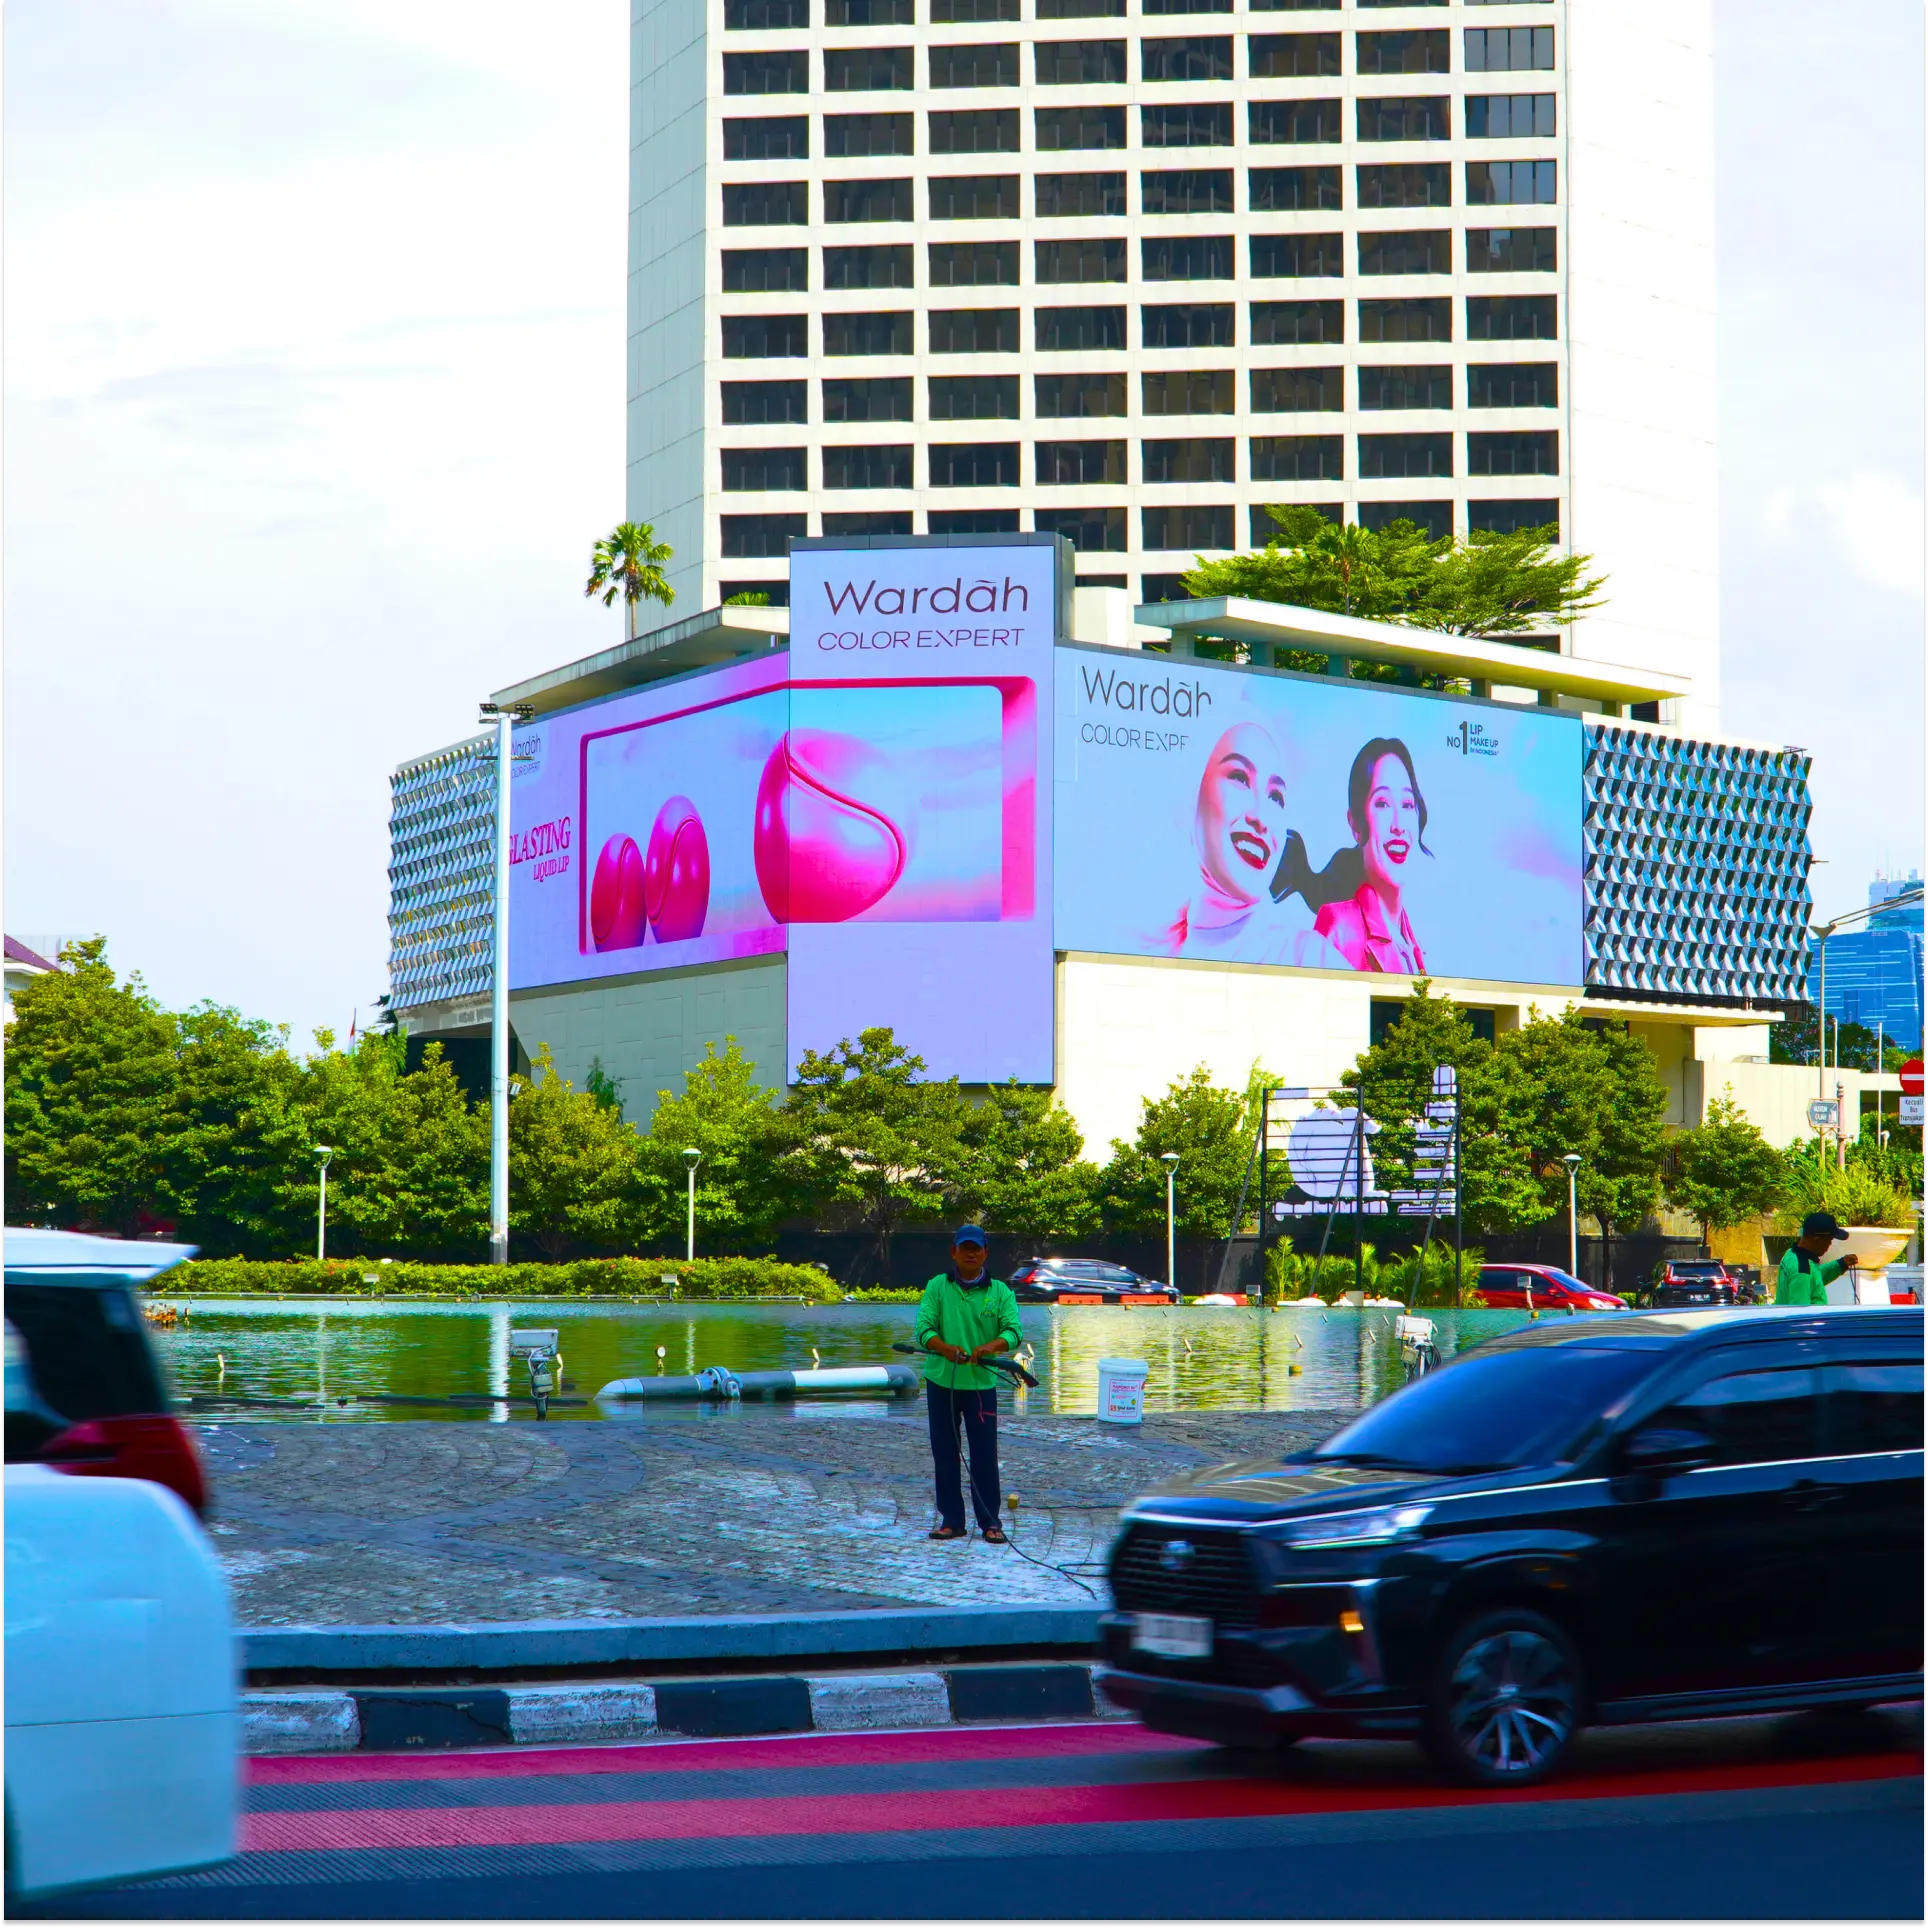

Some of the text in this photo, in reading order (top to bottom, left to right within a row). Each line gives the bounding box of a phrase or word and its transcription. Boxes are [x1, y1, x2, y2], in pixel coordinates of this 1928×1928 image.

[817, 628, 1025, 651] COLOR EXPERT
[1081, 723, 1141, 748] COLOR
[1446, 720, 1468, 755] NO 1
[1470, 723, 1484, 736] LIP
[1470, 736, 1499, 748] MAKE UP
[533, 855, 569, 882] LIQUID LIP
[1905, 1098, 1924, 1106] Kecuali
